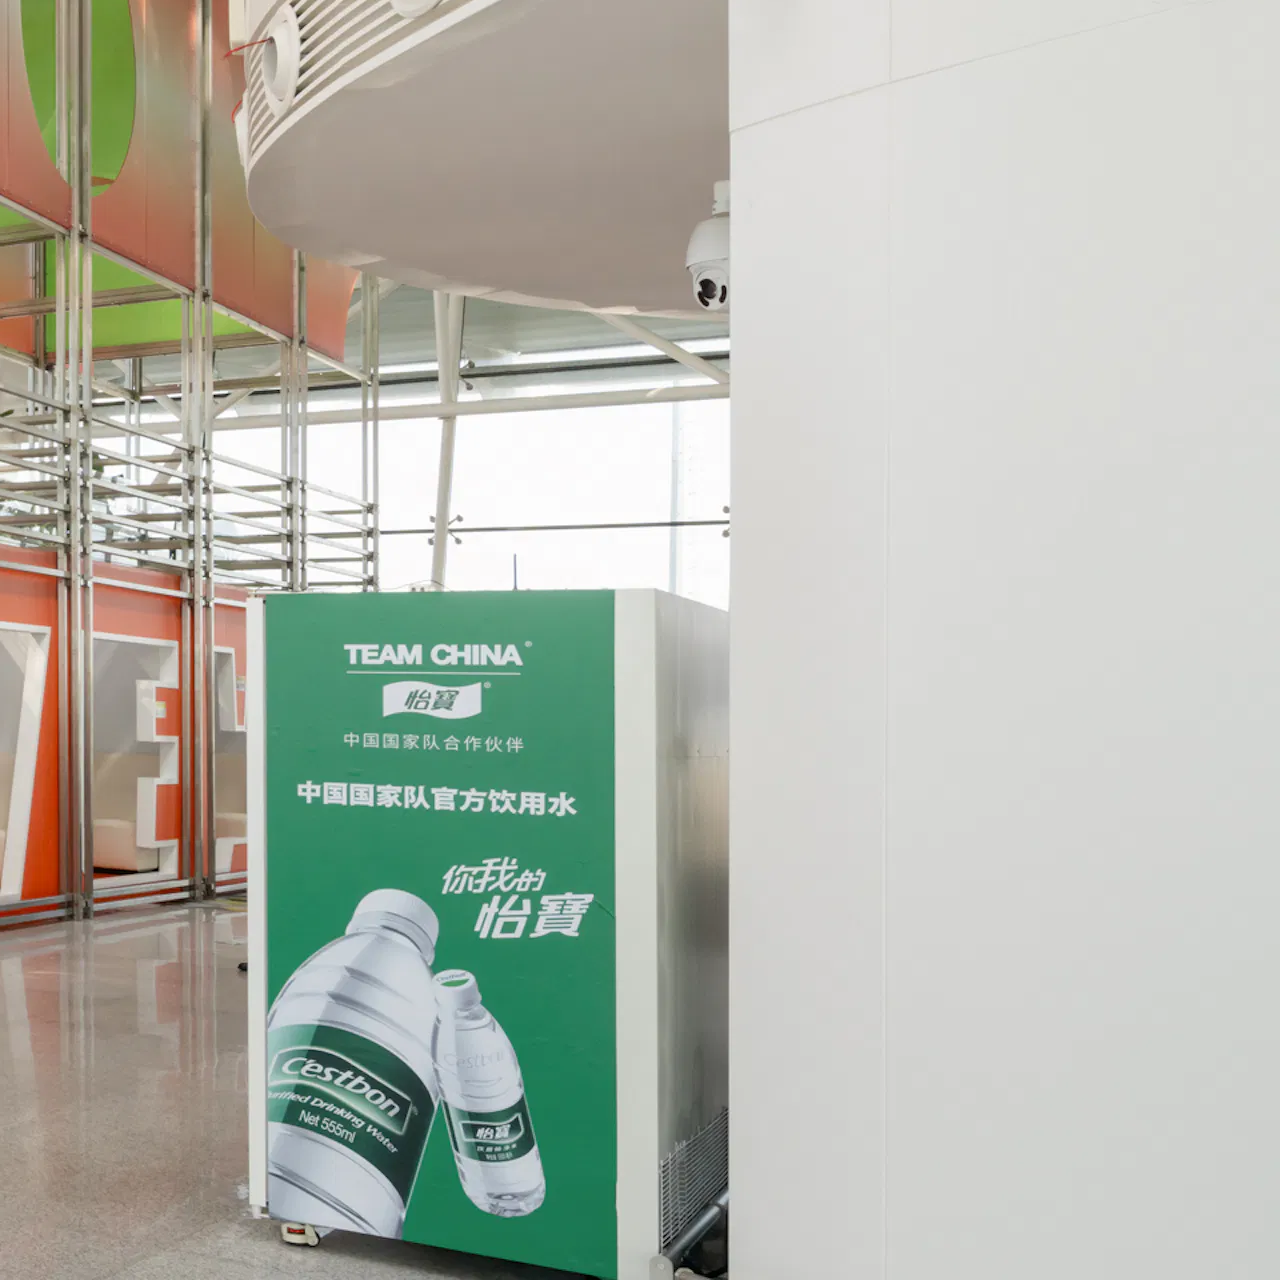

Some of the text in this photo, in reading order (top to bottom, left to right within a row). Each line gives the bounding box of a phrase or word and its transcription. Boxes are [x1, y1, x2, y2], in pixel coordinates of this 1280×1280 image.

[343, 643, 524, 666] TEAM CHINA
[404, 689, 460, 711] 怡寶
[343, 732, 525, 753] 中国国家队合作伙伴
[297, 780, 578, 817] 中国国家队官方饮用水
[441, 856, 547, 895] 你我的
[473, 892, 594, 939] 怡寶
[268, 1091, 398, 1154] urified Drinking Water
[298, 1109, 357, 1144] Net 555ml
